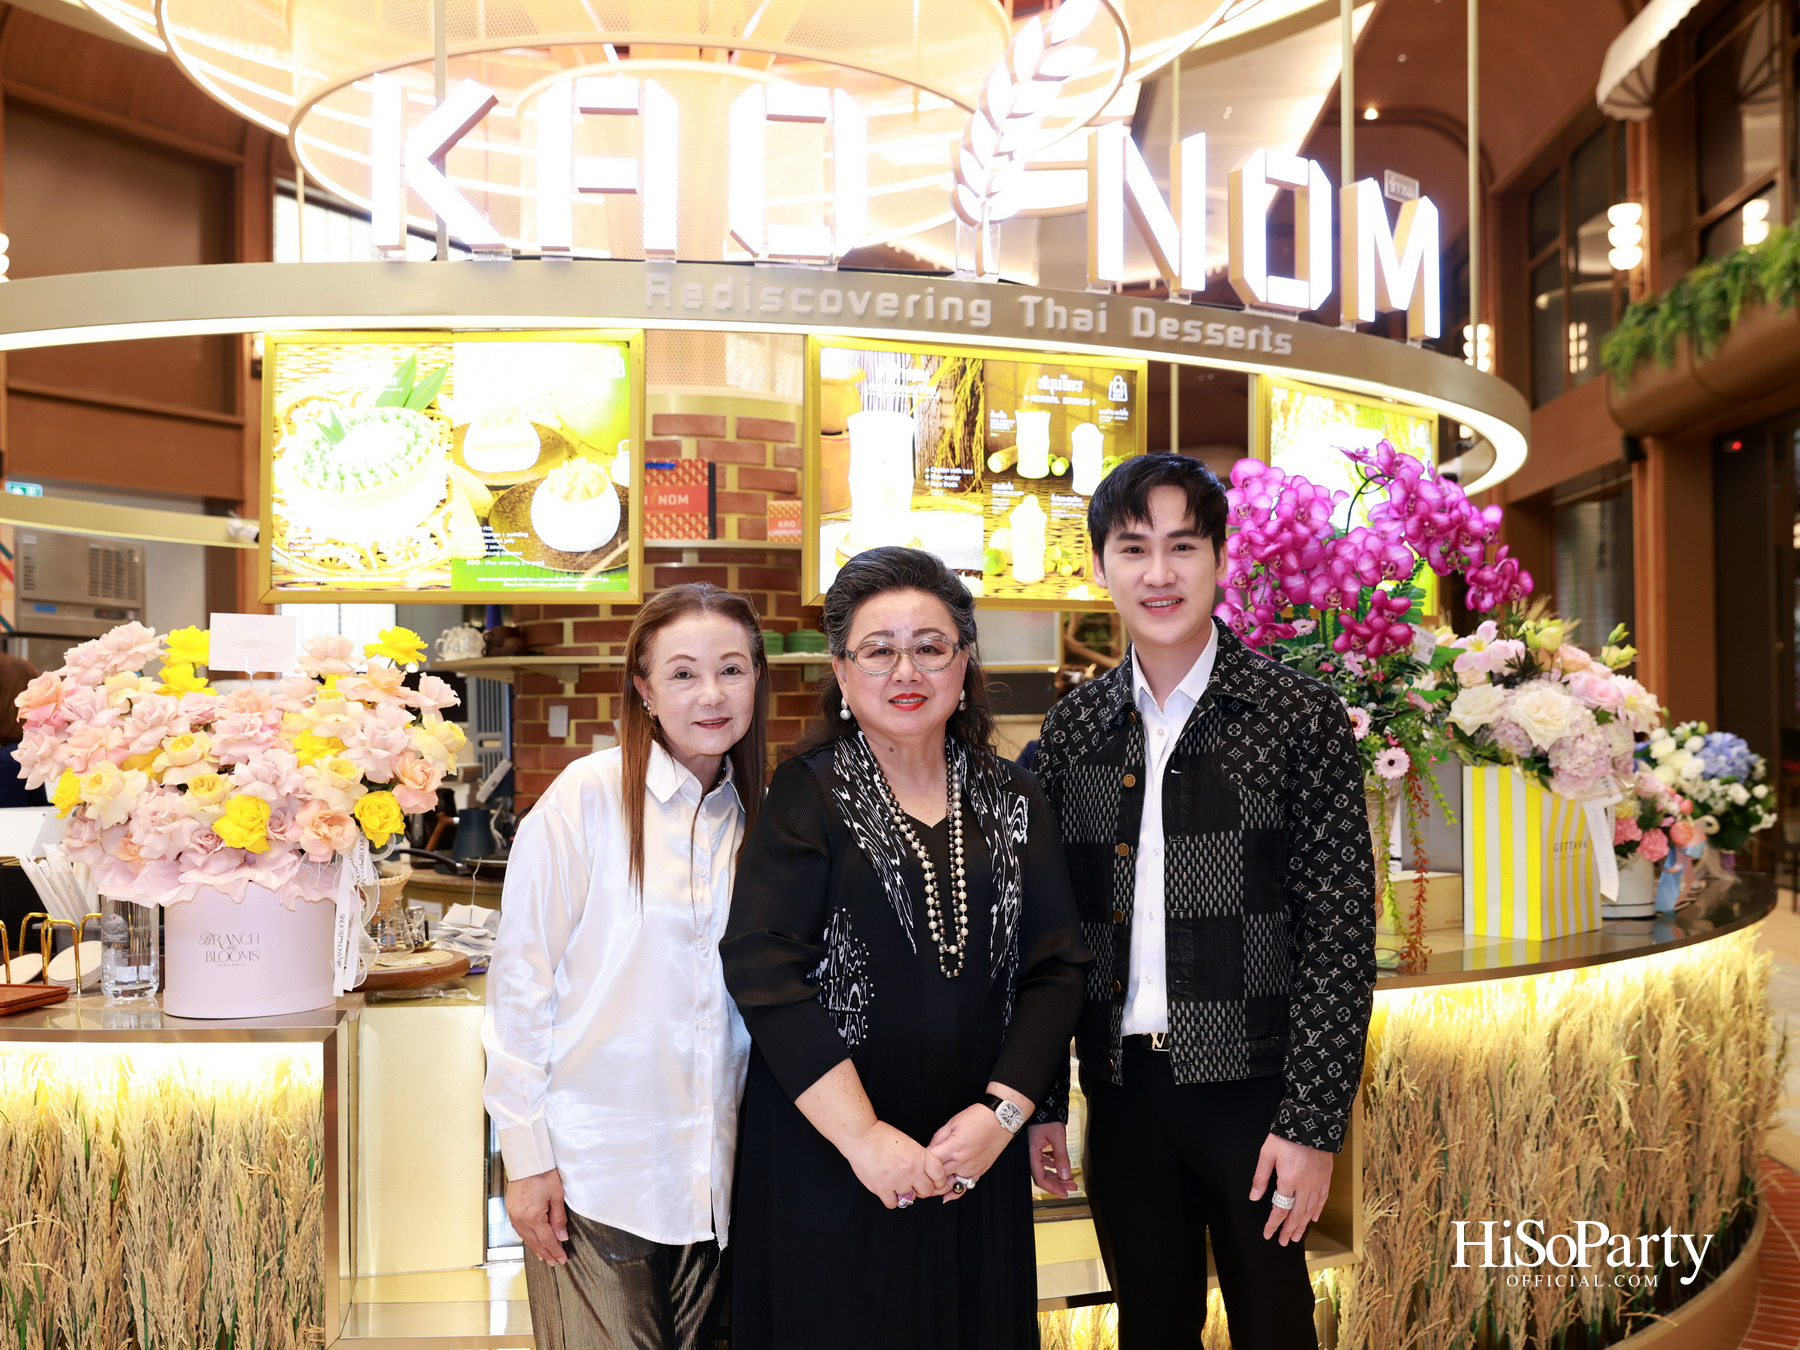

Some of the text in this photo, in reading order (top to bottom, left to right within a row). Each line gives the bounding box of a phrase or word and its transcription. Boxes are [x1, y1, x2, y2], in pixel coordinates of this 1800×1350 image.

[371, 73, 1441, 340] KAO NOM
[644, 273, 1293, 355] Rediscovering Thai Desserts
[658, 494, 689, 505] NOM
[199, 932, 260, 950] BRANCH
[205, 950, 260, 963] BLOOMS
